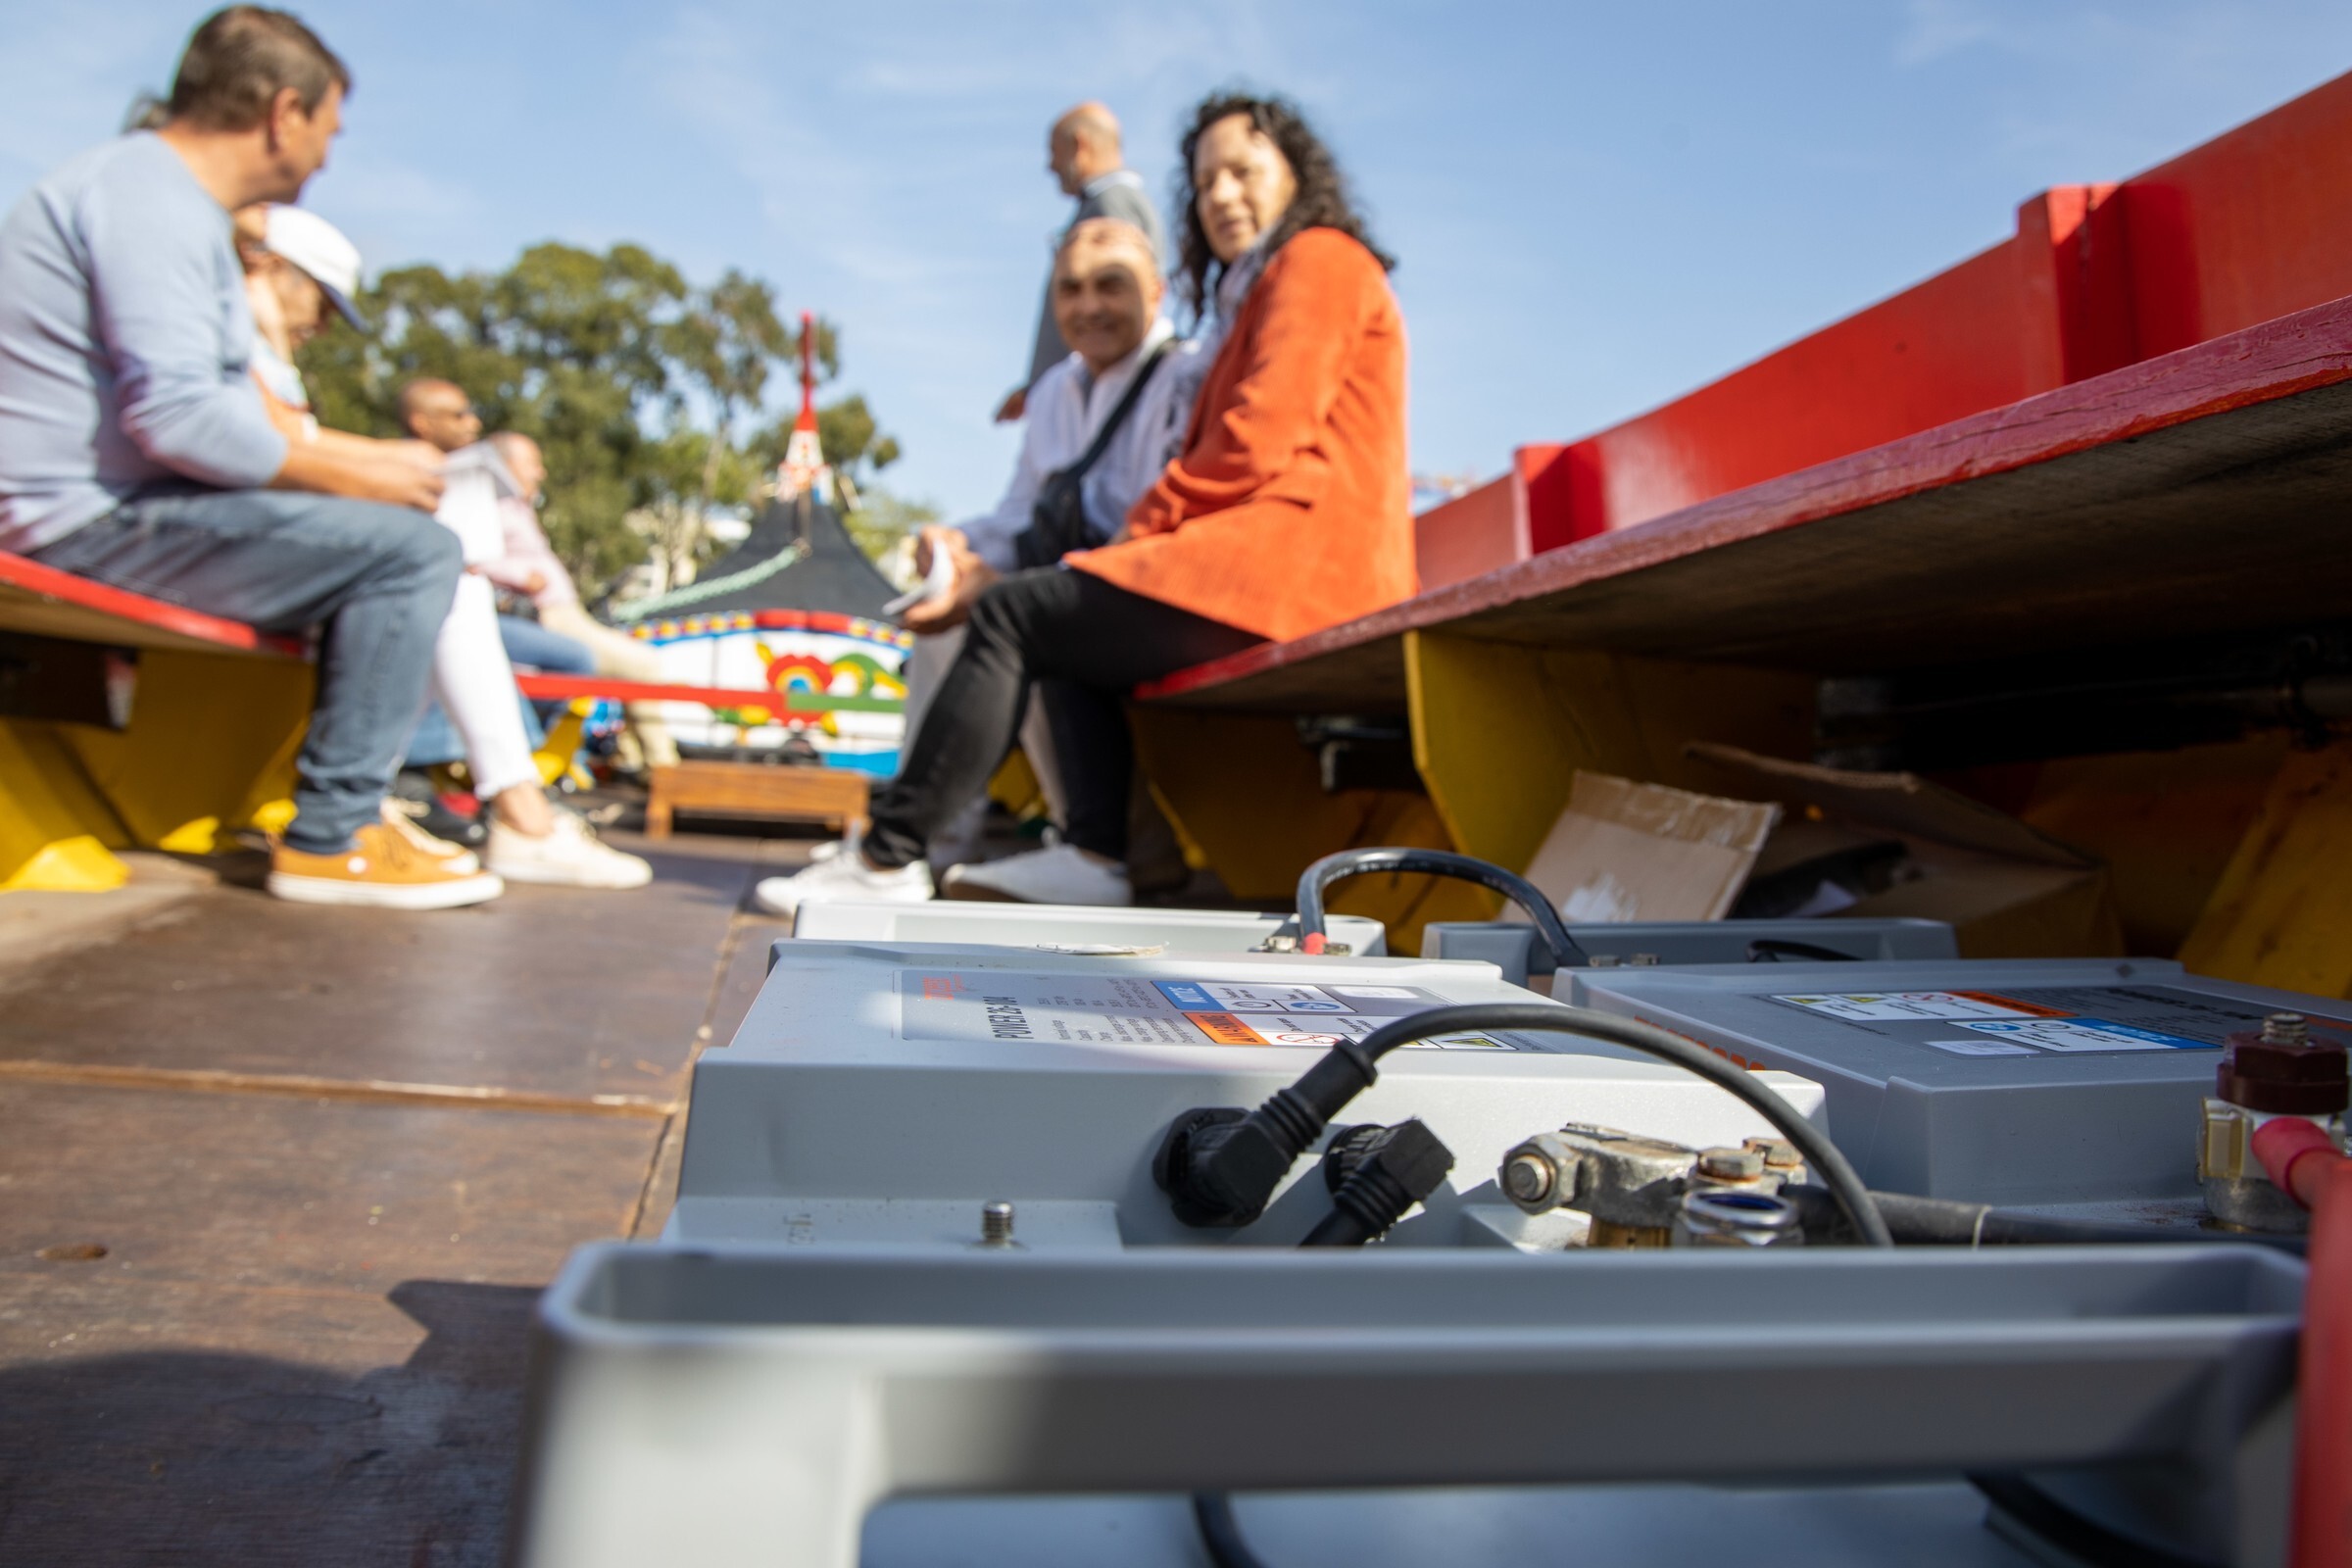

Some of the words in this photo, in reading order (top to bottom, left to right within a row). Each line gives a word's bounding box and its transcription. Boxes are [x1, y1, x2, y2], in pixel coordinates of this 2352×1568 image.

[982, 995, 1021, 1014] 26-104
[1167, 986, 1209, 1003] NOTICE
[988, 1014, 1033, 1039] POWER
[1199, 1015, 1250, 1037] WARNING
